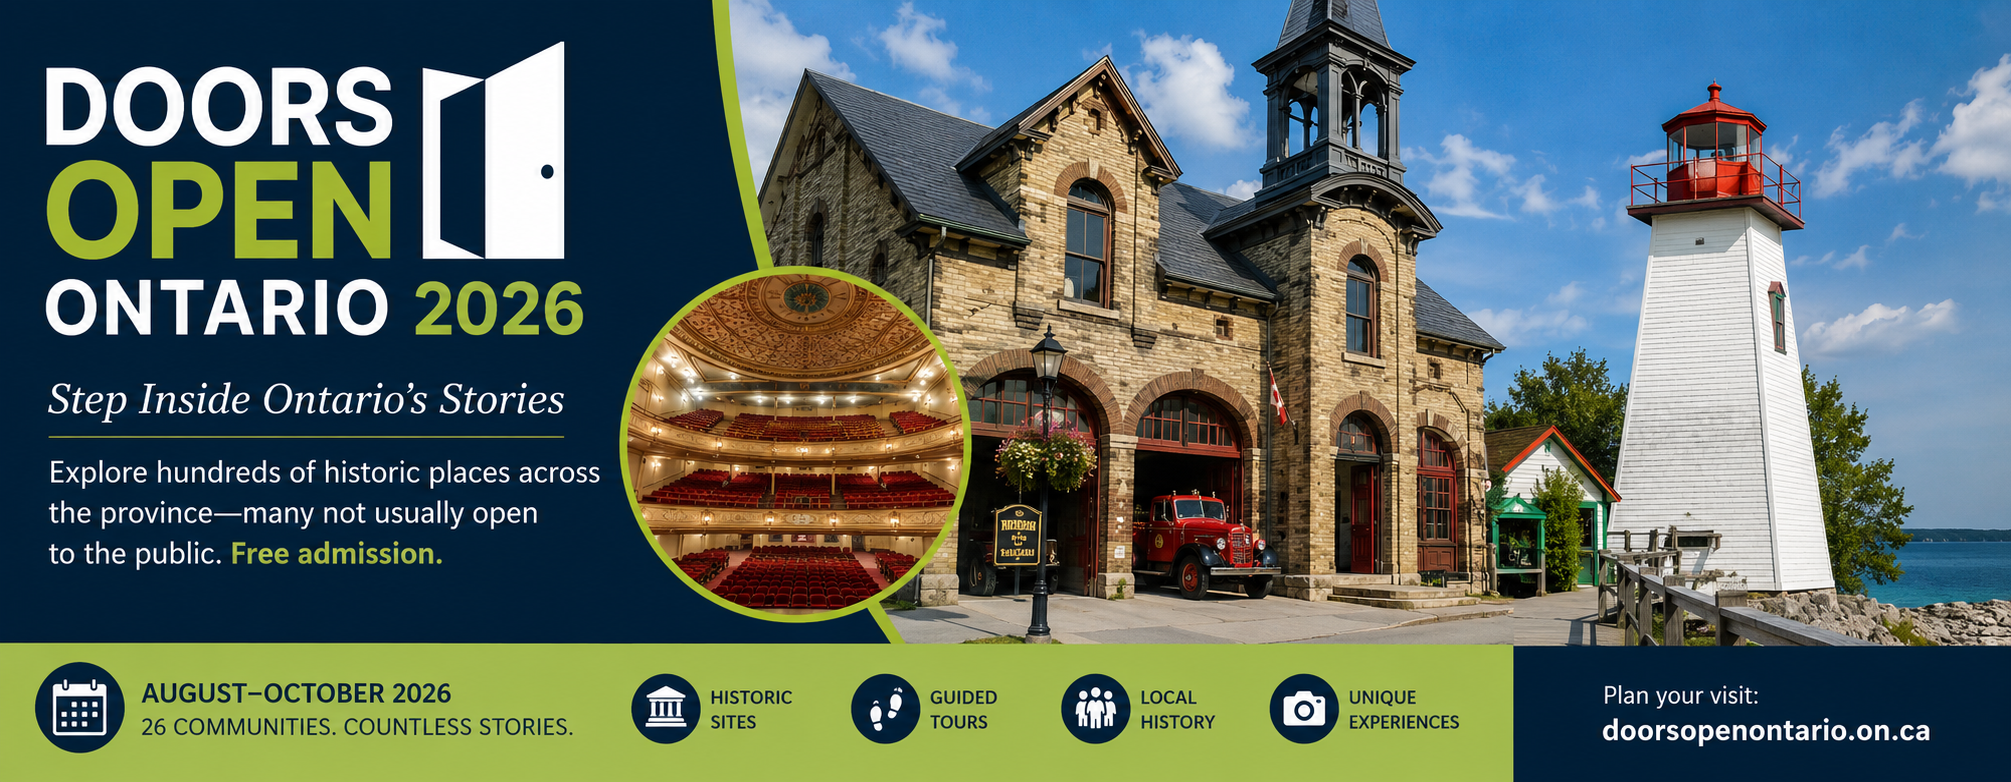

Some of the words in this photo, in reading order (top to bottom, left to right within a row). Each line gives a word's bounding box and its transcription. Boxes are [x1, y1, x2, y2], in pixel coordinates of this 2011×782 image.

[45, 65, 393, 147] DOORS
[46, 159, 391, 261] OPEN
[45, 278, 389, 337] ONTARIO
[415, 280, 584, 336] 2026
[47, 382, 128, 424] Step
[138, 381, 251, 415] Inside
[263, 382, 428, 415] Ontario’s
[439, 382, 565, 415] Stories
[50, 459, 148, 490] Explore
[157, 459, 281, 484] hundreds
[289, 459, 317, 484] of
[325, 459, 420, 484] historic
[429, 459, 511, 490] places
[519, 466, 601, 484] across
[48, 499, 92, 524] the
[323, 502, 367, 524] not
[375, 499, 465, 530] usually
[472, 506, 538, 530] open
[48, 543, 75, 565] to
[83, 540, 127, 565] the
[135, 540, 222, 571] public.
[232, 541, 289, 565] Free
[298, 540, 442, 565] admission.
[392, 682, 452, 704] 2026
[711, 690, 793, 705] HISTORIC
[930, 690, 998, 705] GUIDED
[1141, 689, 1198, 705] LOCAL
[1349, 689, 1417, 707] UNIQUE
[1604, 684, 1649, 705] Plan
[1655, 690, 1704, 710] your
[1709, 685, 1759, 705] visit:
[141, 717, 167, 736] 26
[173, 717, 337, 736] COMMUNITIES.
[344, 717, 472, 736] COUNTLESS
[479, 717, 573, 736] STORIES.
[710, 714, 757, 730] SITES
[929, 714, 988, 730] TOURS
[1141, 714, 1216, 730] HISTORY
[1349, 714, 1460, 730] EXPERIENCES
[1602, 717, 1930, 748] doorsopenontario.on.ca
